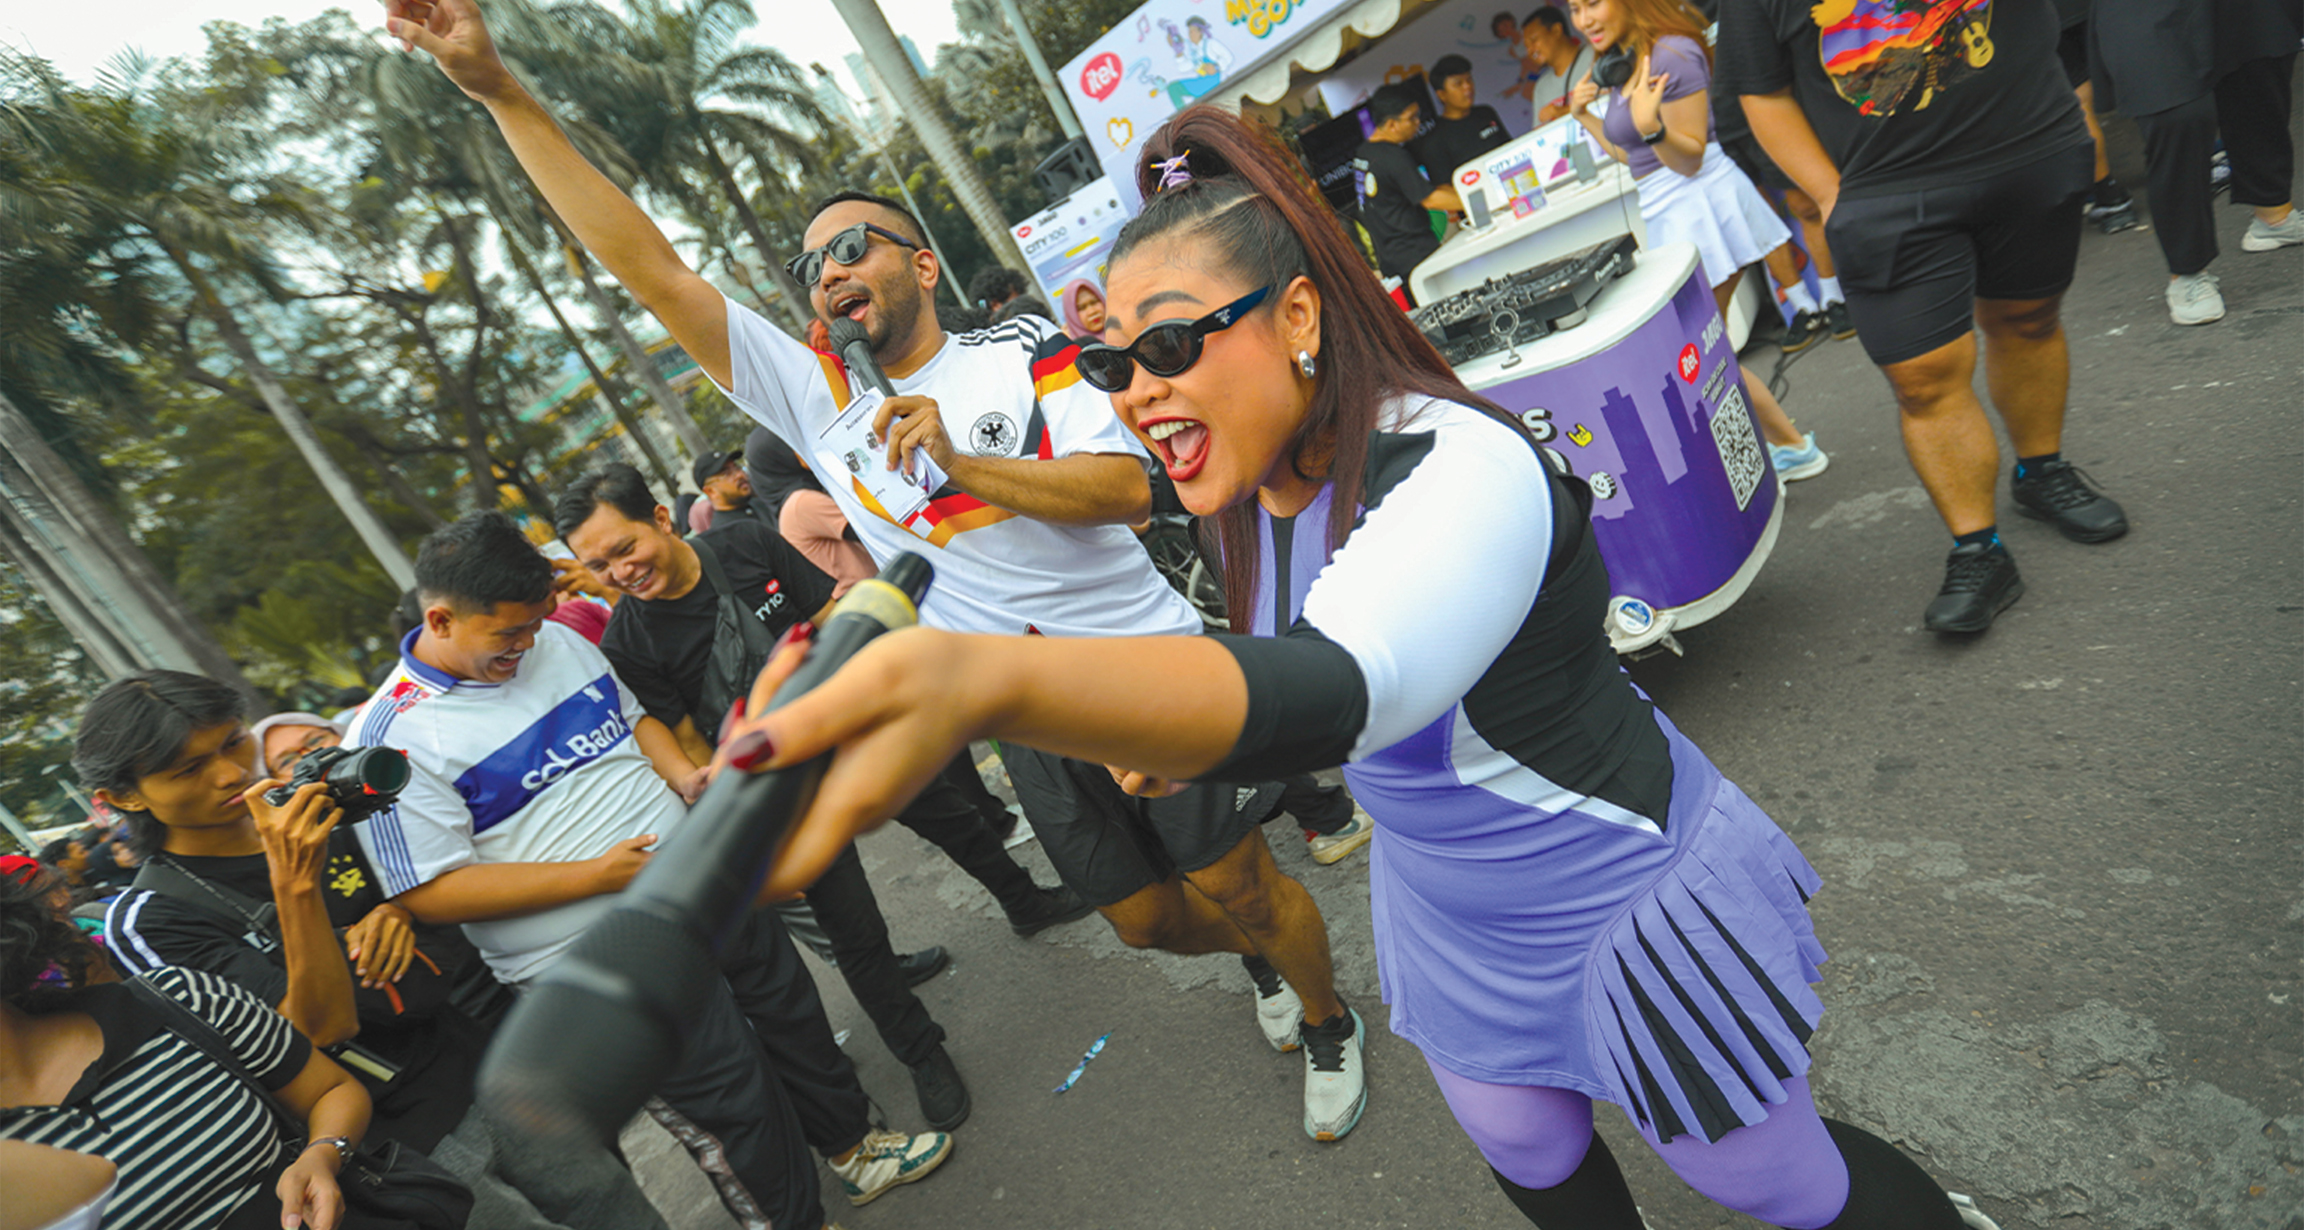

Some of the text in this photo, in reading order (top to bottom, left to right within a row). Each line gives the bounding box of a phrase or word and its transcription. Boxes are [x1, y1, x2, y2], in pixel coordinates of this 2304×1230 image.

[1085, 56, 1119, 94] itel
[1025, 236, 1047, 255] CITY
[1682, 347, 1699, 378] itel
[565, 708, 627, 758] Bank
